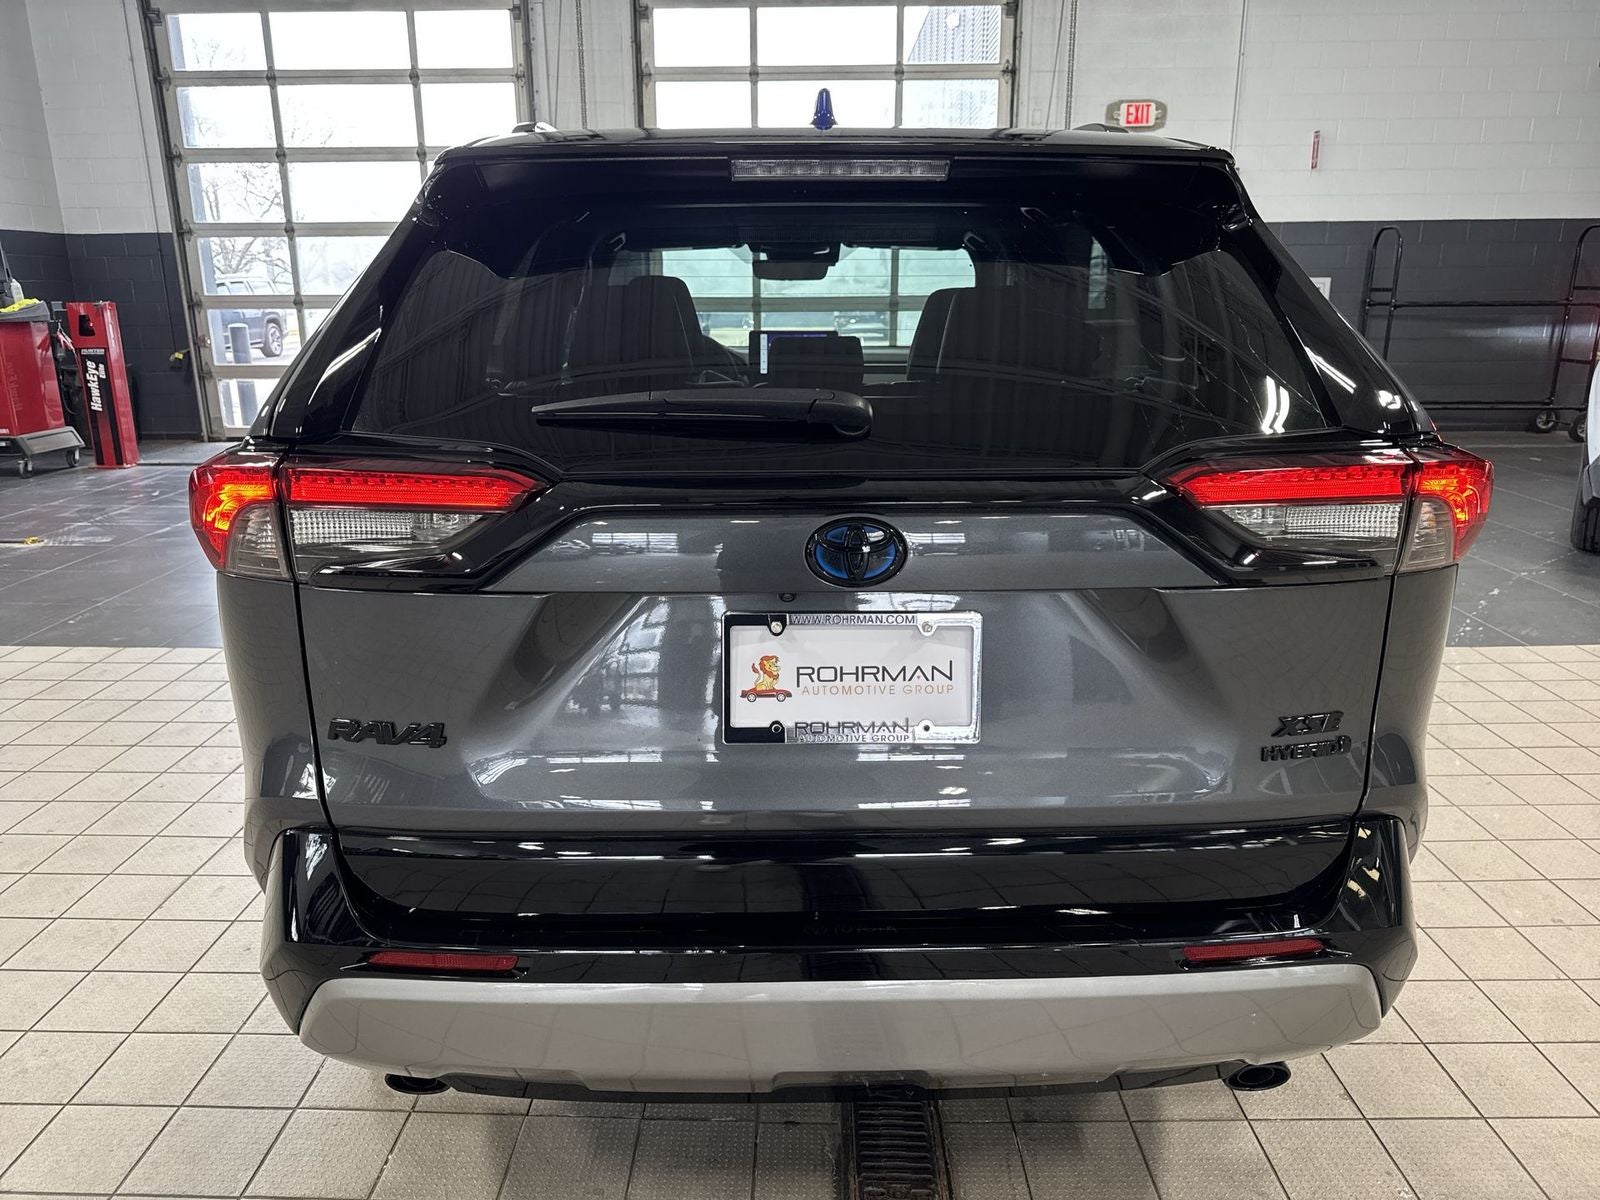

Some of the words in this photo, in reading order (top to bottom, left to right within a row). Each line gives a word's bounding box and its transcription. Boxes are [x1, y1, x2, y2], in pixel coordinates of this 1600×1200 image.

[1126, 104, 1151, 124] EXIT
[86, 360, 103, 412] HawkEye
[792, 614, 915, 624] WWW.ROHRMAN.COM
[796, 660, 953, 688] ROHRMAN
[801, 685, 895, 695] AUTOMOTIVE
[903, 685, 954, 695] GROUP
[328, 718, 447, 748] RAV4
[795, 718, 909, 738] ROHRMAN
[800, 734, 867, 743] AUTOMOTIVE
[872, 734, 910, 743] GROUP
